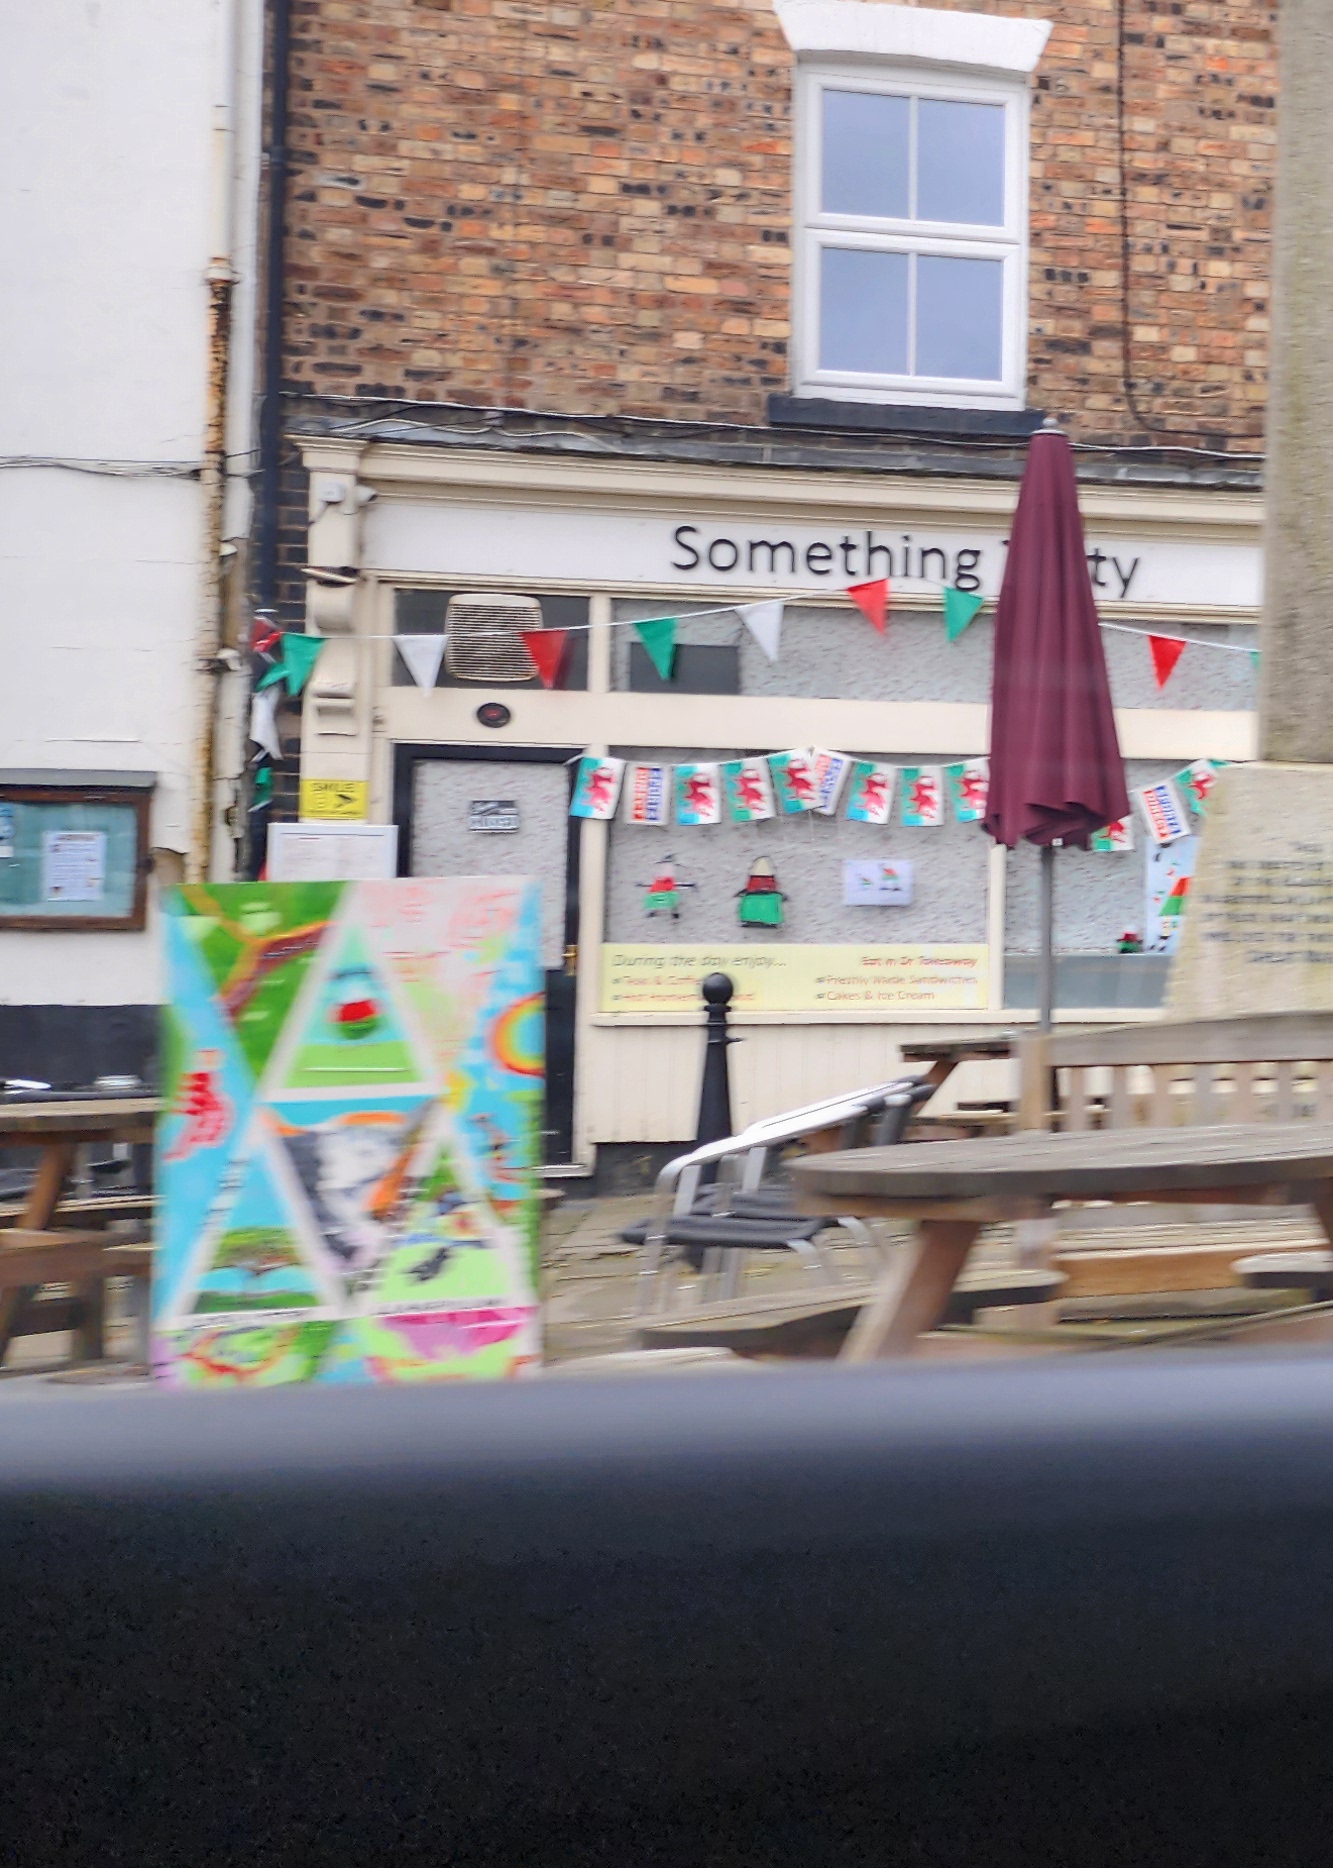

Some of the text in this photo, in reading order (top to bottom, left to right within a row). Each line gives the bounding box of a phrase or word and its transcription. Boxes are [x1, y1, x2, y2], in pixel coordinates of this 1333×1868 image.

[671, 525, 981, 592] Something
[612, 954, 666, 969] During
[671, 955, 697, 967] the
[701, 955, 729, 968] day
[826, 990, 862, 1001] Cakes
[864, 990, 874, 1001] &
[897, 990, 935, 1001] Cream
